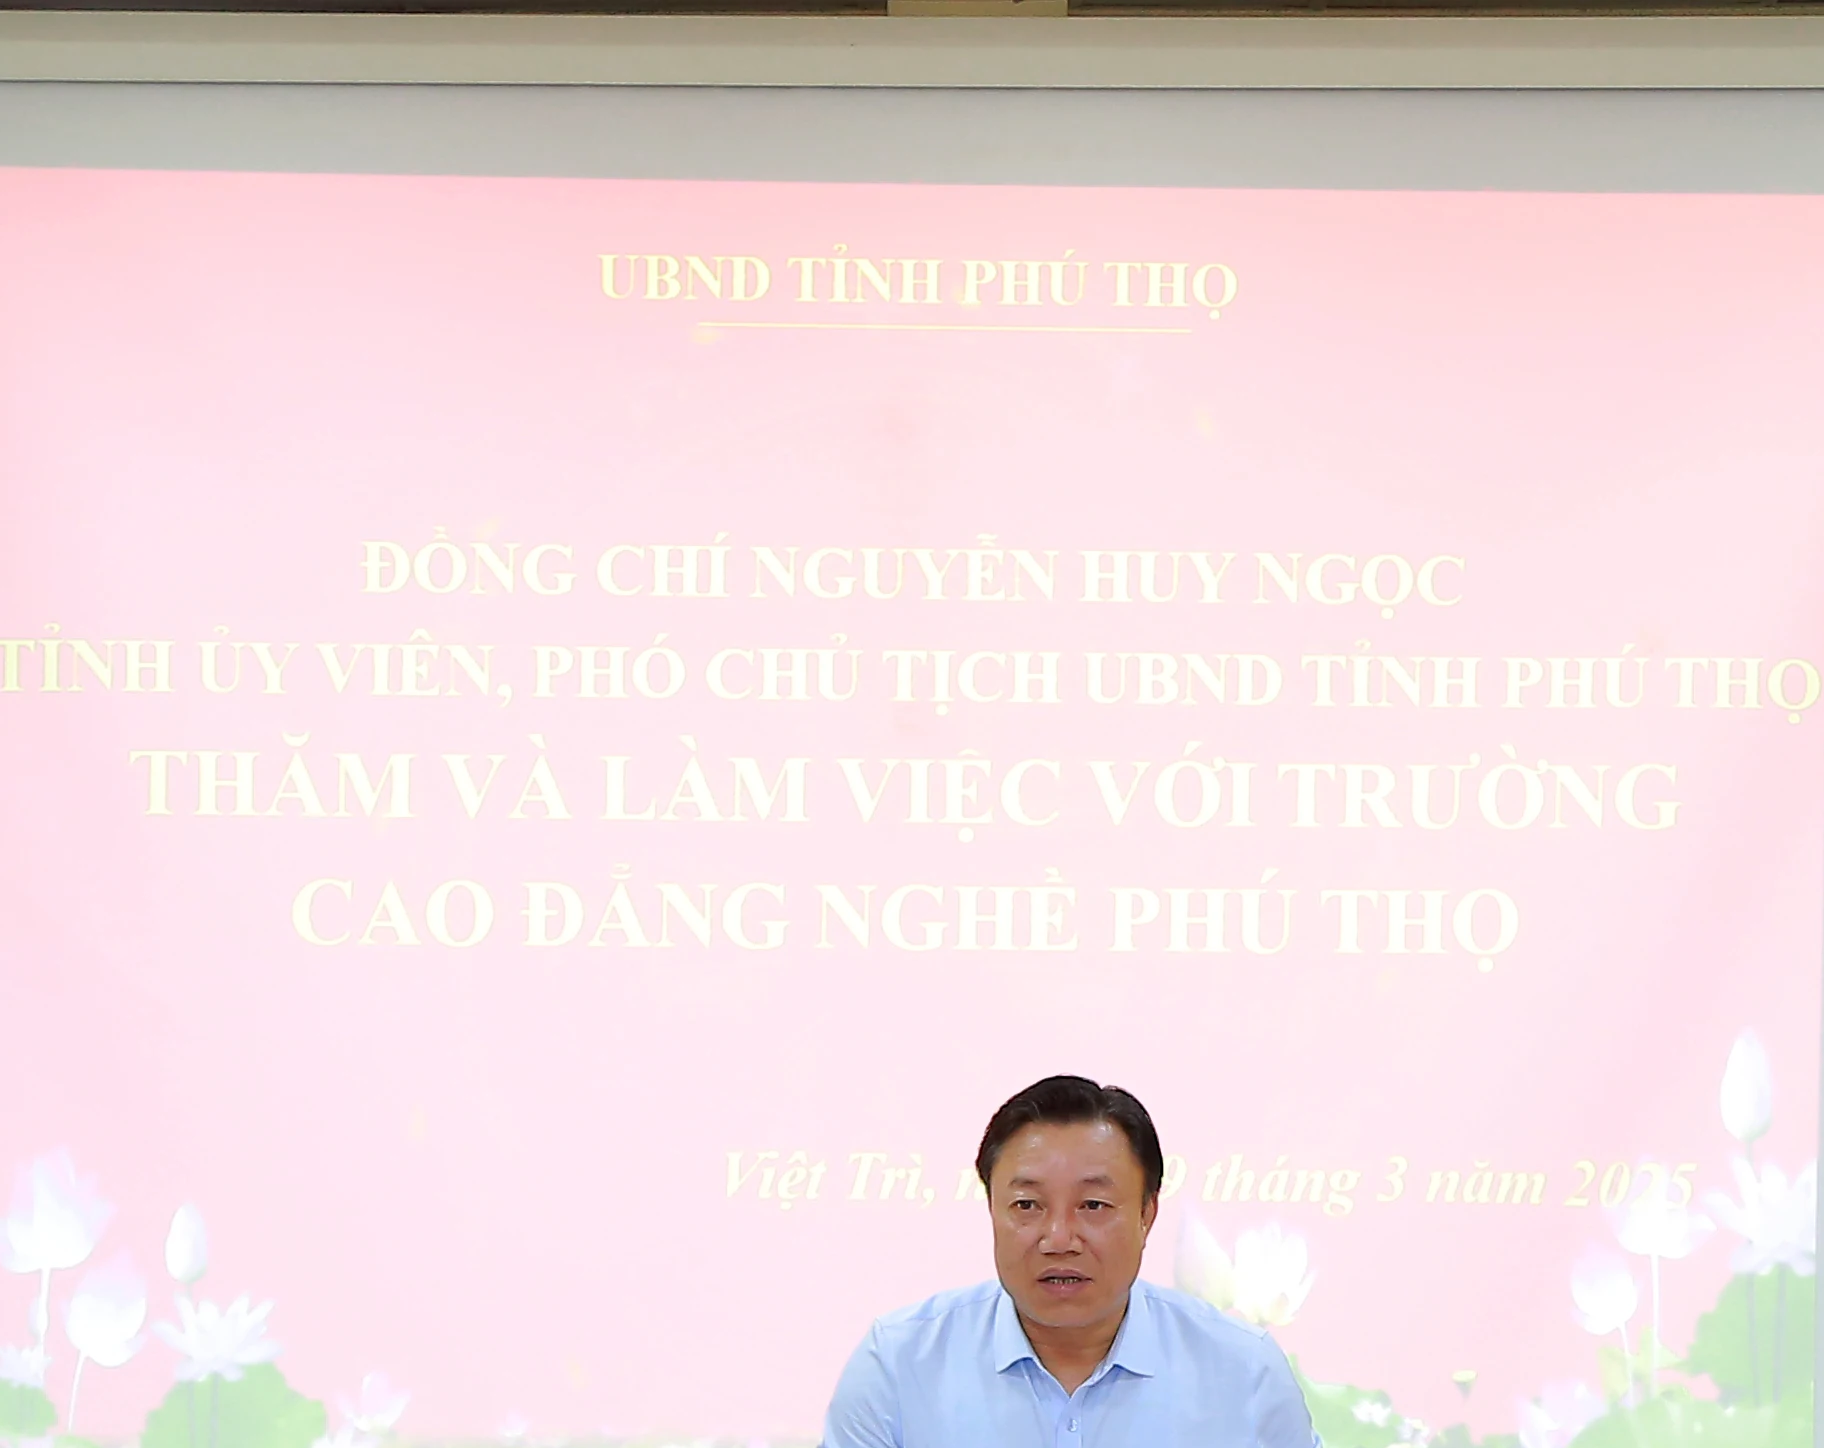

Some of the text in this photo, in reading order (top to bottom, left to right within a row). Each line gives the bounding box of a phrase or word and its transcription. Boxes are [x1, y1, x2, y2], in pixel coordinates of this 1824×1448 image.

[597, 244, 1238, 319] UBND TỈNH PHÚ THỌ
[360, 525, 1465, 619] ĐỒNG CHÍ NGUYỄN HUY NGỌC
[198, 626, 299, 695] ỦY
[315, 628, 513, 708] VIÊN,
[532, 633, 686, 699] PHÓ
[705, 633, 864, 701] CHỦ
[882, 649, 1062, 716] TỊCH
[1084, 652, 1283, 706] UBND
[1301, 640, 1482, 708] TỈNH
[1502, 644, 1650, 709] PHÚ
[1664, 658, 1822, 724] THỌ
[129, 731, 1683, 843] THĂM VÀ LÀM VIỆC VỚI TRƯỜNG
[292, 864, 1519, 973] CAO ĐẲNG NGHỀ PHÚ THỌ
[725, 1150, 827, 1210] Việt
[1202, 1153, 1361, 1217] tháng
[1377, 1156, 1408, 1202] 3
[1425, 1159, 1548, 1206] năm
